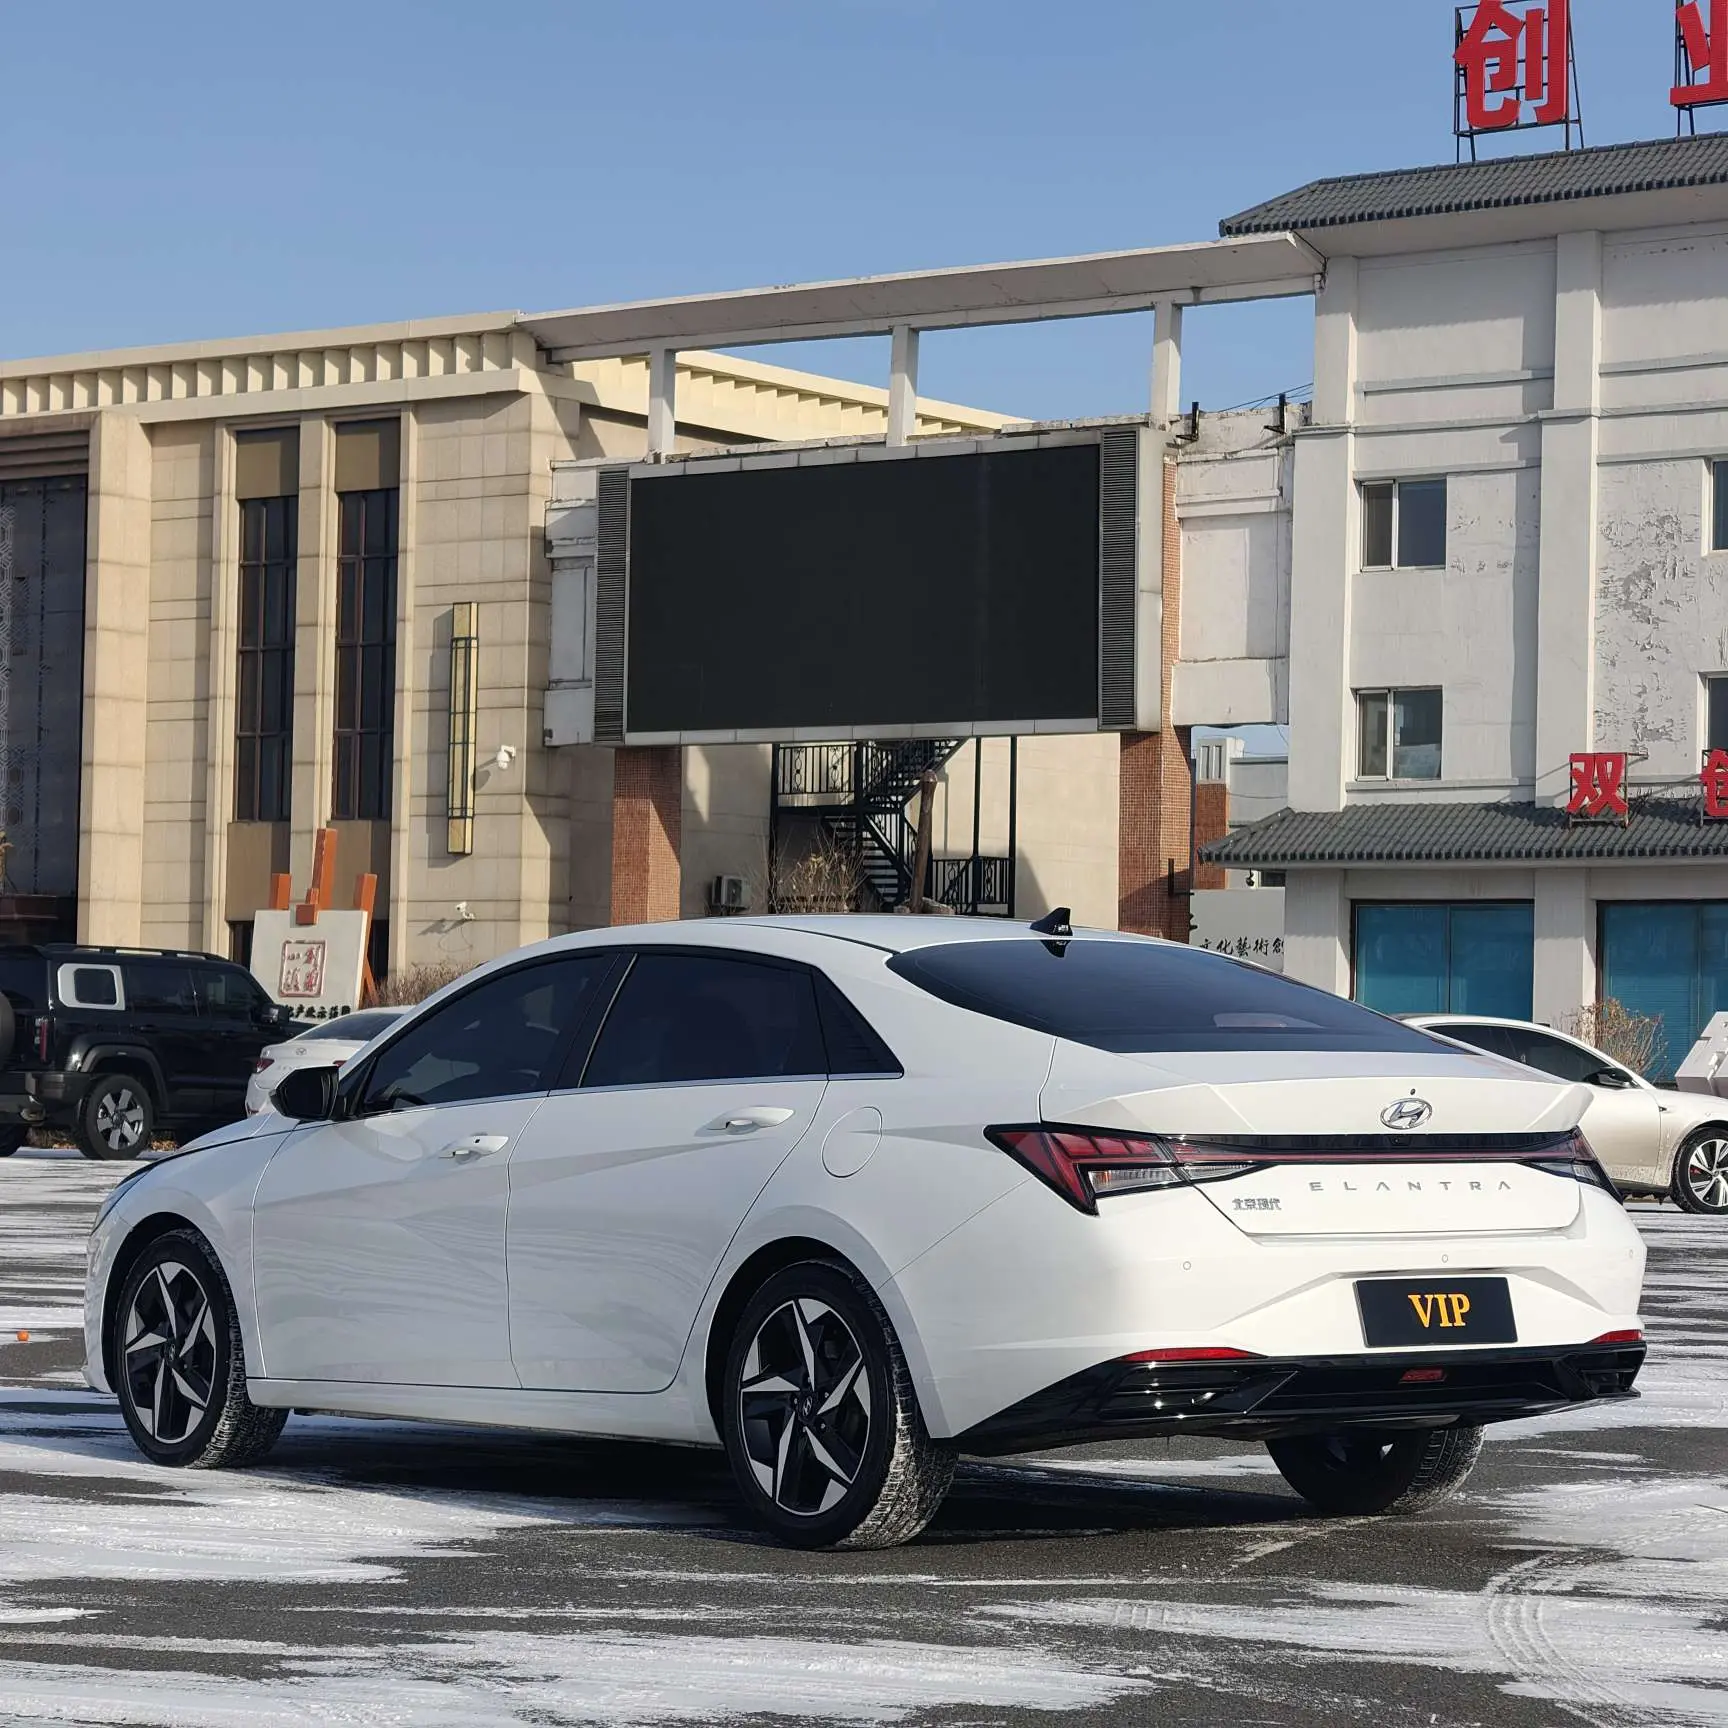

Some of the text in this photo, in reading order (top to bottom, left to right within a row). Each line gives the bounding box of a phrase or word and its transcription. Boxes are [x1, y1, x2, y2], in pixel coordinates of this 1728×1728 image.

[1309, 1180, 1512, 1192] ELANTRA
[1231, 1198, 1282, 1211] 北京现代
[1407, 1293, 1471, 1328] VIP
